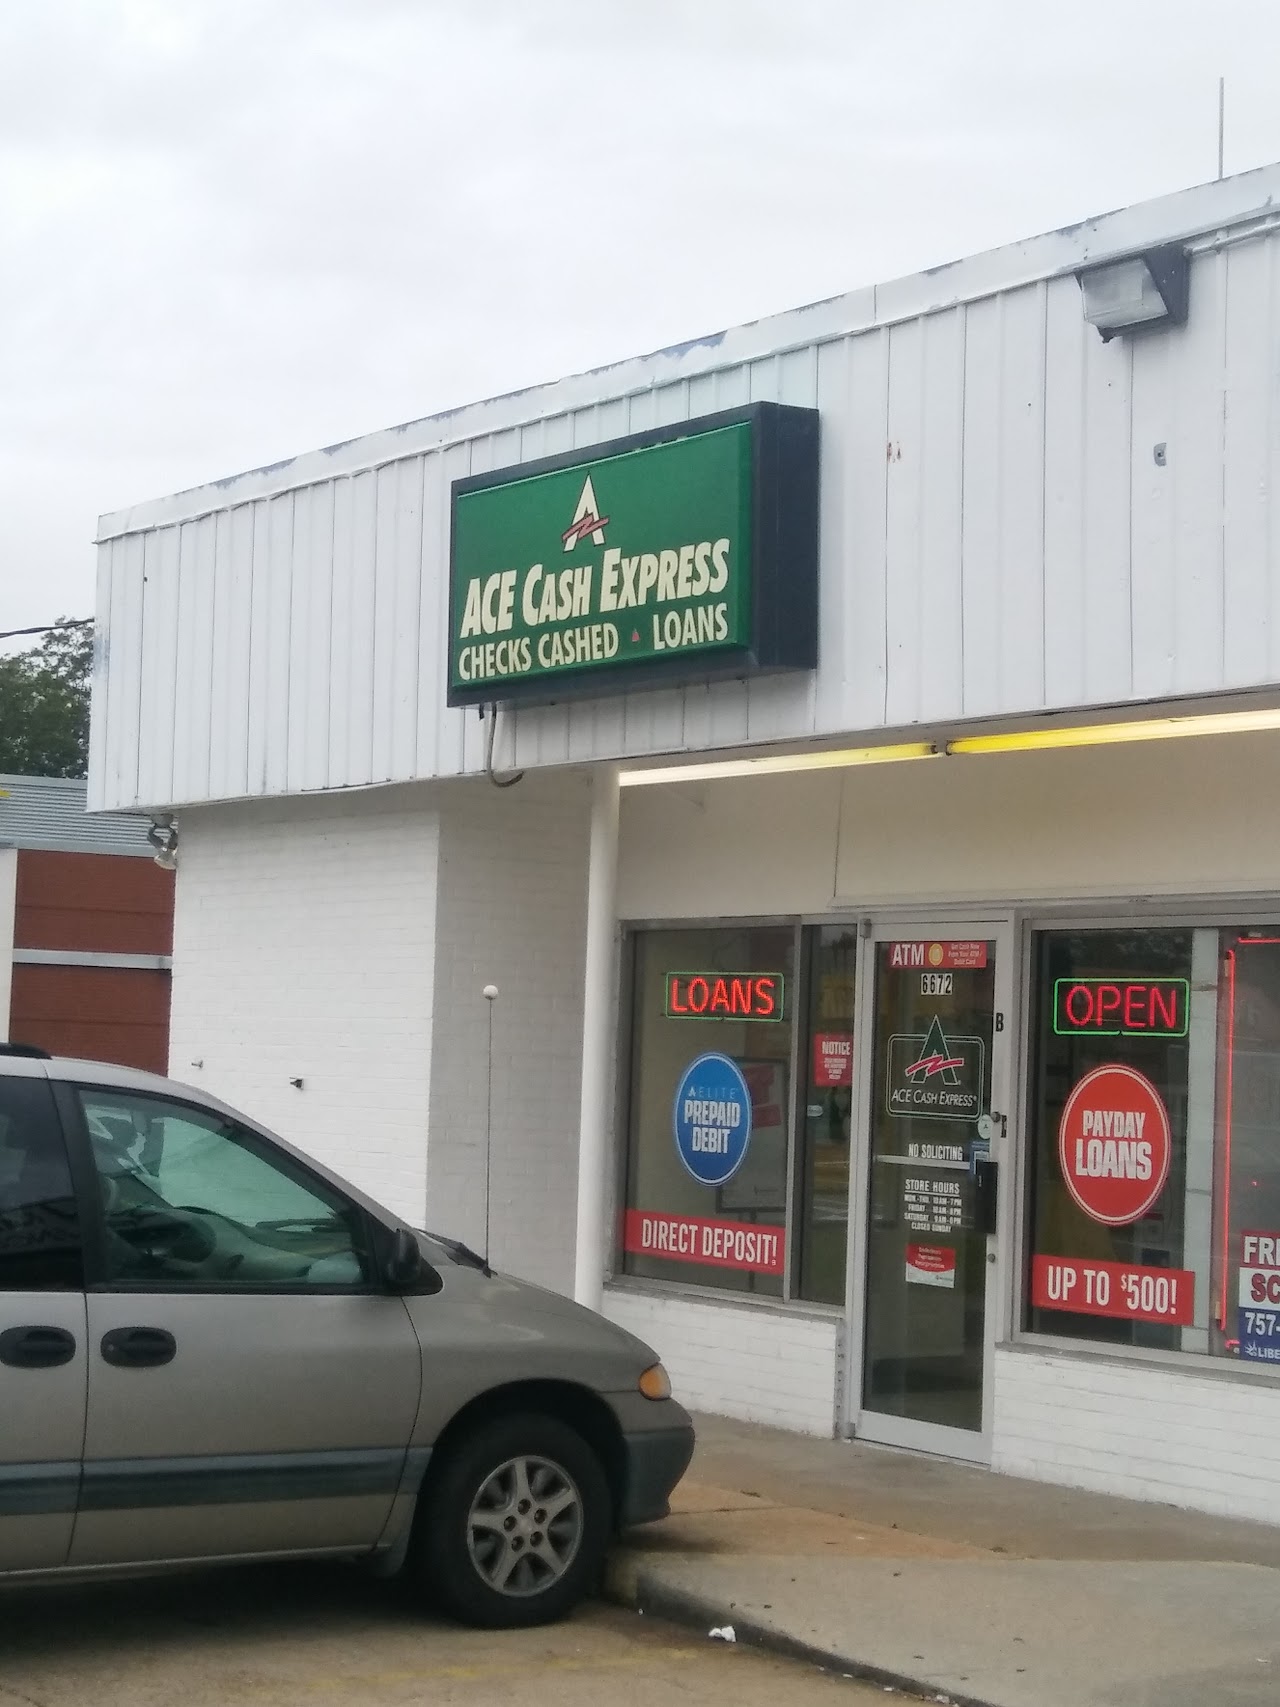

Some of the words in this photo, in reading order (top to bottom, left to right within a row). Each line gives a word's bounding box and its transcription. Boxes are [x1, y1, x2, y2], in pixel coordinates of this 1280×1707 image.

[460, 570, 517, 638] ACE
[522, 564, 593, 626] CASH
[600, 538, 731, 612] EXPRESS
[459, 637, 531, 680] CHECKS
[538, 623, 619, 668] CASHED
[653, 603, 728, 650] LOANS
[891, 943, 925, 966] ATM
[671, 978, 775, 1015] LOANS
[922, 974, 952, 994] 6672
[1066, 985, 1177, 1029] OPEN
[995, 1013, 1004, 1032] B
[822, 1041, 851, 1056] NOTICE
[891, 1088, 912, 1103] ACE
[913, 1089, 938, 1104] CASH
[684, 1099, 741, 1128] PREPAID
[1082, 1110, 1146, 1139] PAYDAY
[692, 1126, 731, 1154] DEBIT
[908, 1143, 919, 1158] NO
[921, 1144, 963, 1161] SOLICITING
[1075, 1138, 1152, 1180] LOANS
[905, 1178, 930, 1191] STORE
[932, 1181, 960, 1194] HOURS
[642, 1218, 699, 1254] DIRECT
[702, 1226, 778, 1266] DEPOSIT!
[1047, 1265, 1077, 1301] UP
[1083, 1269, 1110, 1306] TO
[1120, 1273, 1177, 1315] $500!
[1250, 1273, 1280, 1304] SC
